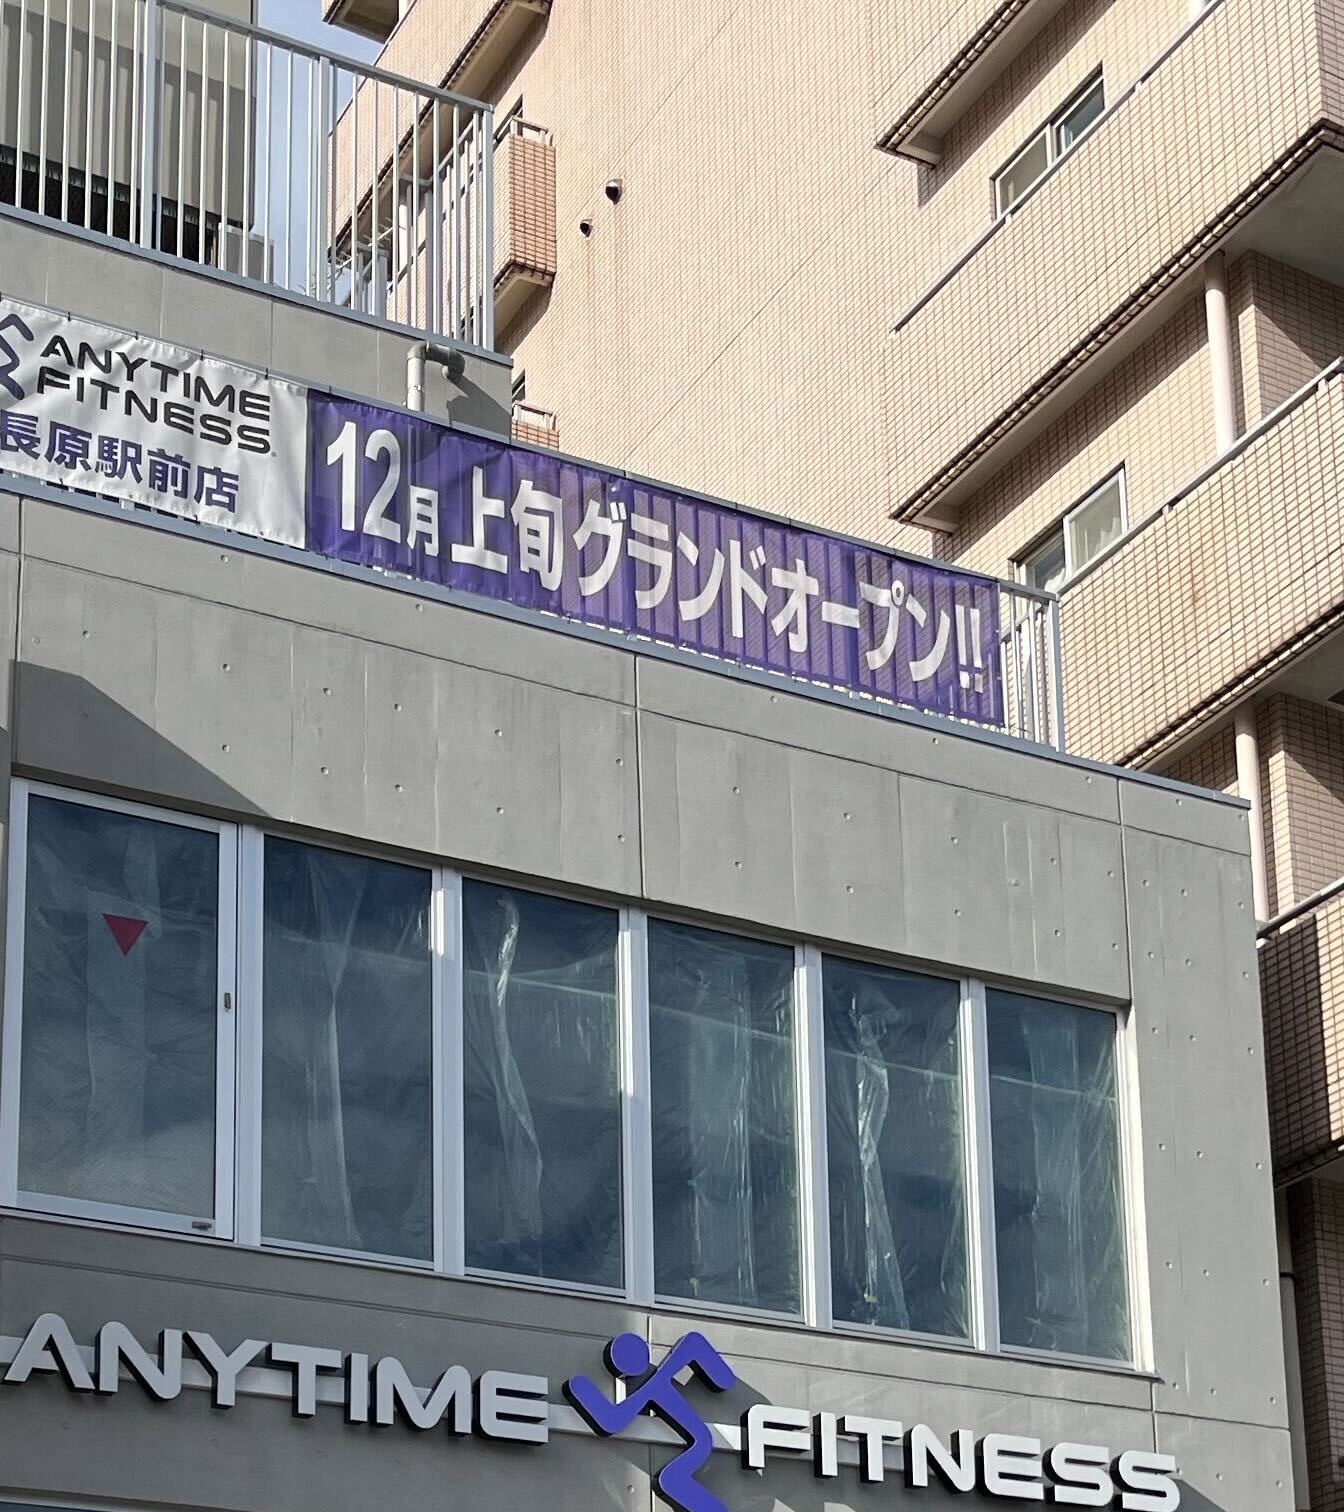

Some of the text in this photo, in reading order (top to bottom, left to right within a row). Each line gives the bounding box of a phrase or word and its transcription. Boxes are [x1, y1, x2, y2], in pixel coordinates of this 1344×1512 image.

[35, 365, 271, 454] FITNESS
[39, 333, 271, 421] ANYTIME
[2, 1313, 549, 1445] ANYTIME
